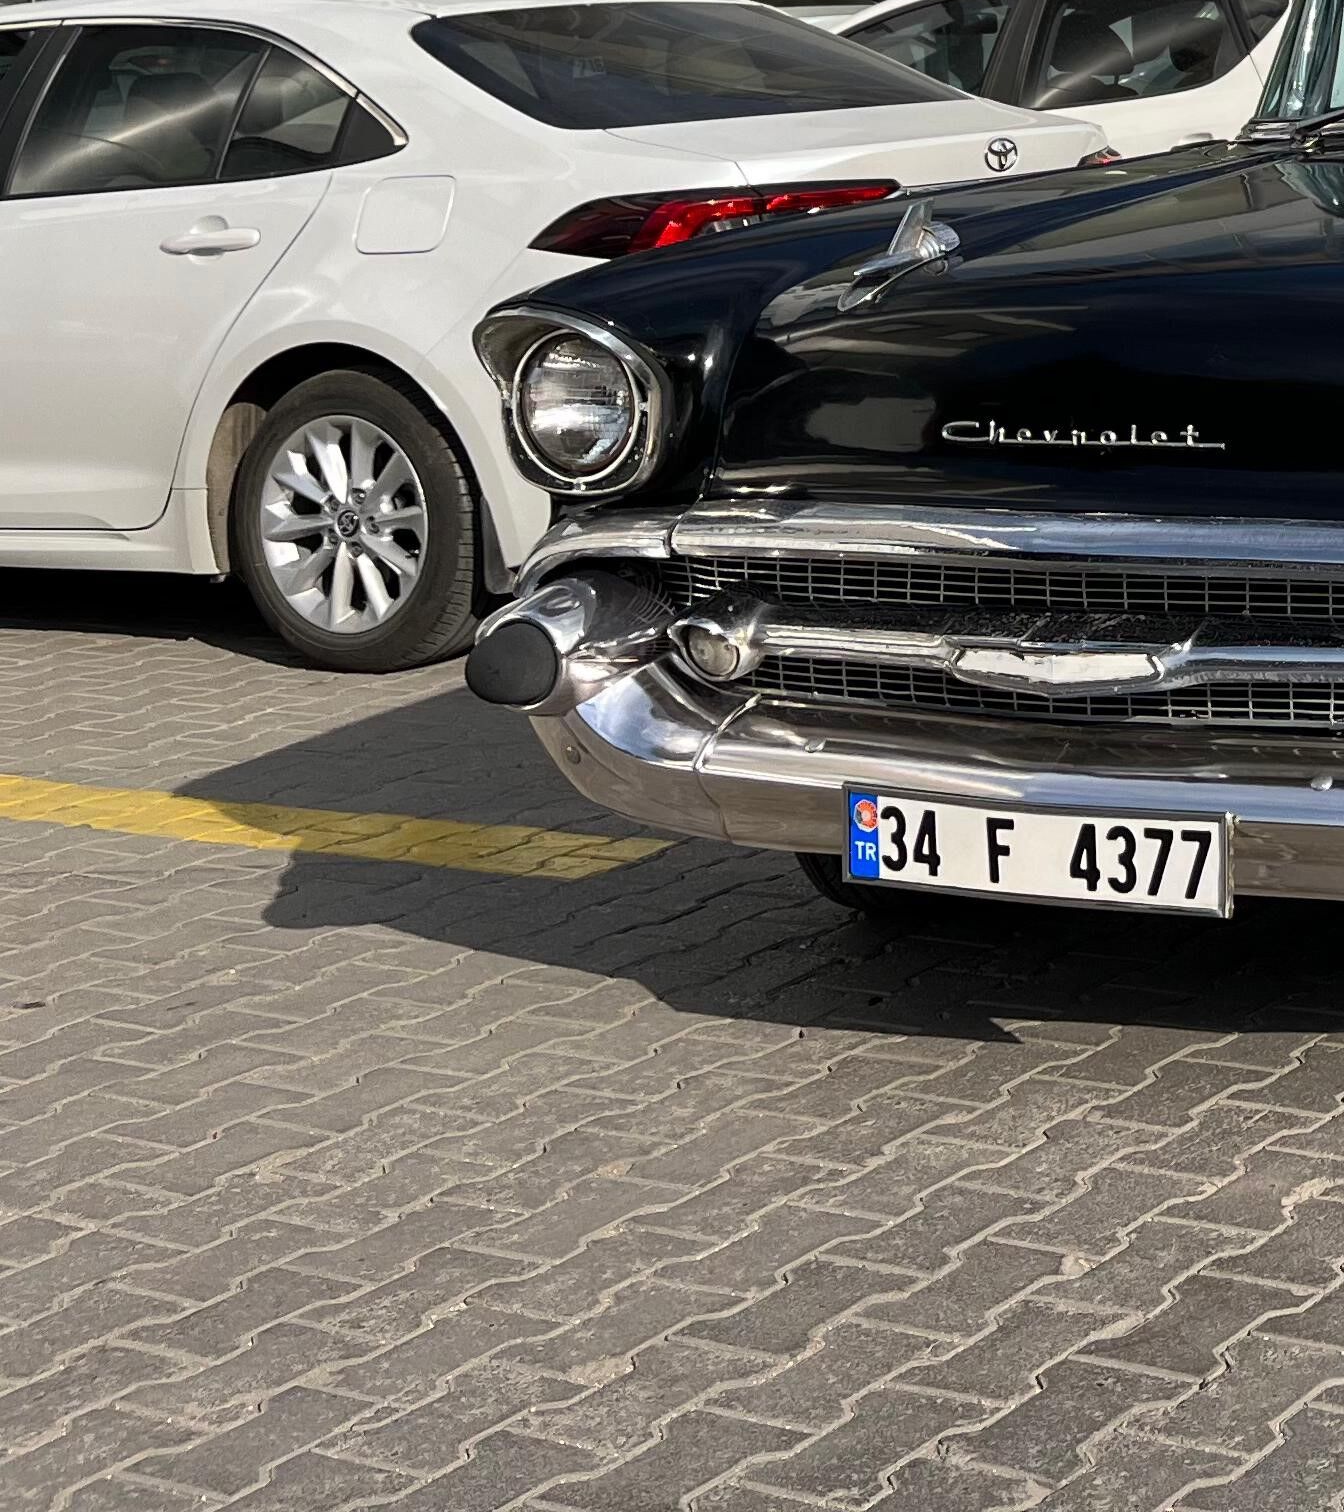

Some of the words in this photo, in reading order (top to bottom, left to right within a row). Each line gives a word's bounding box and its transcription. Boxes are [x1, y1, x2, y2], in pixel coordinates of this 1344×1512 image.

[854, 840, 878, 863] TR
[880, 804, 941, 877] 34
[985, 816, 1015, 884] F
[1069, 823, 1212, 900] 4377
